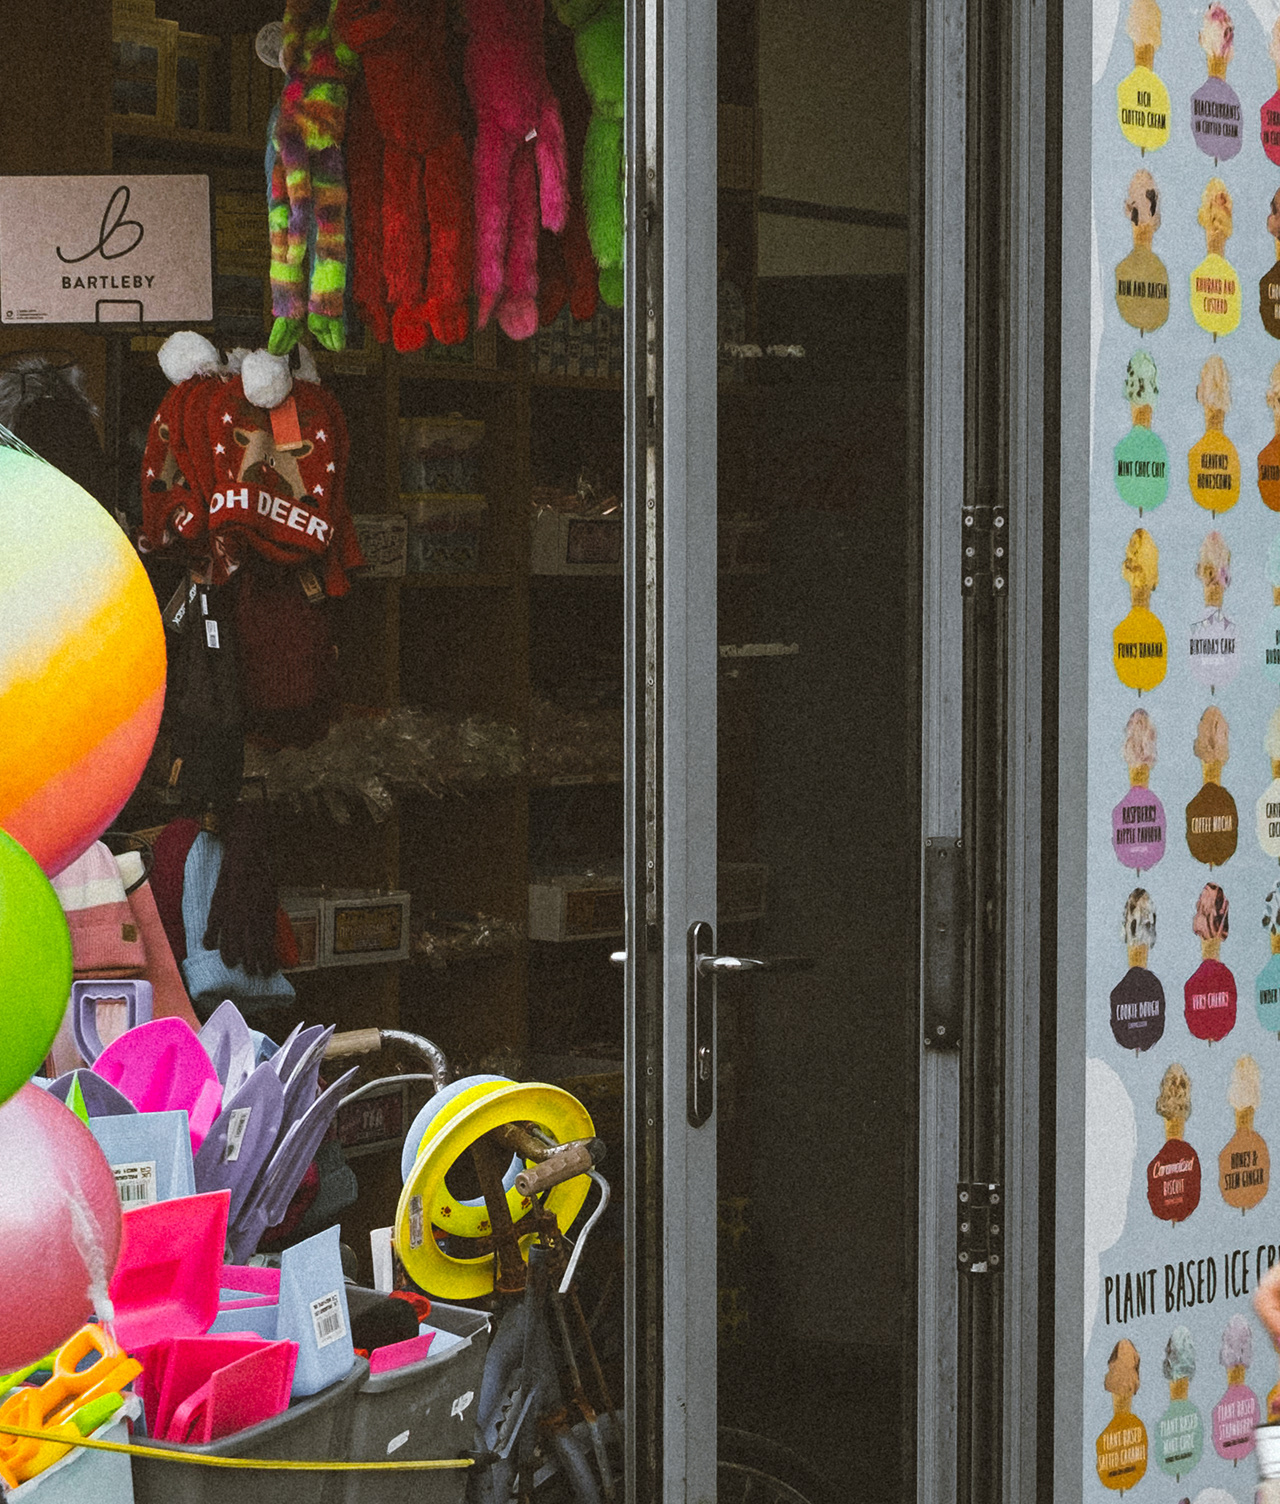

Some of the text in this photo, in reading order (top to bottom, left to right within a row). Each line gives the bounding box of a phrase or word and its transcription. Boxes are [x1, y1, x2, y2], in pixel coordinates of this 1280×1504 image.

[1137, 91, 1151, 107] RICH
[1121, 109, 1166, 130] CLOTTED CREAM
[61, 275, 156, 289] BARTLEBY
[1118, 460, 1165, 478] MINT CHOC CHIP
[210, 488, 249, 514] OH
[1118, 642, 1137, 660] FUNKY
[1189, 638, 1235, 656] BIRTHDAY CAKE
[1122, 804, 1157, 824] RASPBERRY
[1191, 817, 1212, 834] COFFEE
[1192, 993, 1206, 1010] VERY
[1259, 986, 1277, 1005] UNDER
[1116, 1000, 1160, 1021] COOKIE DOUGH
[1231, 1151, 1251, 1169] HONEY
[1224, 1168, 1264, 1191] STEM GINGER
[1104, 1249, 1250, 1325] PLANT BASED ICE
